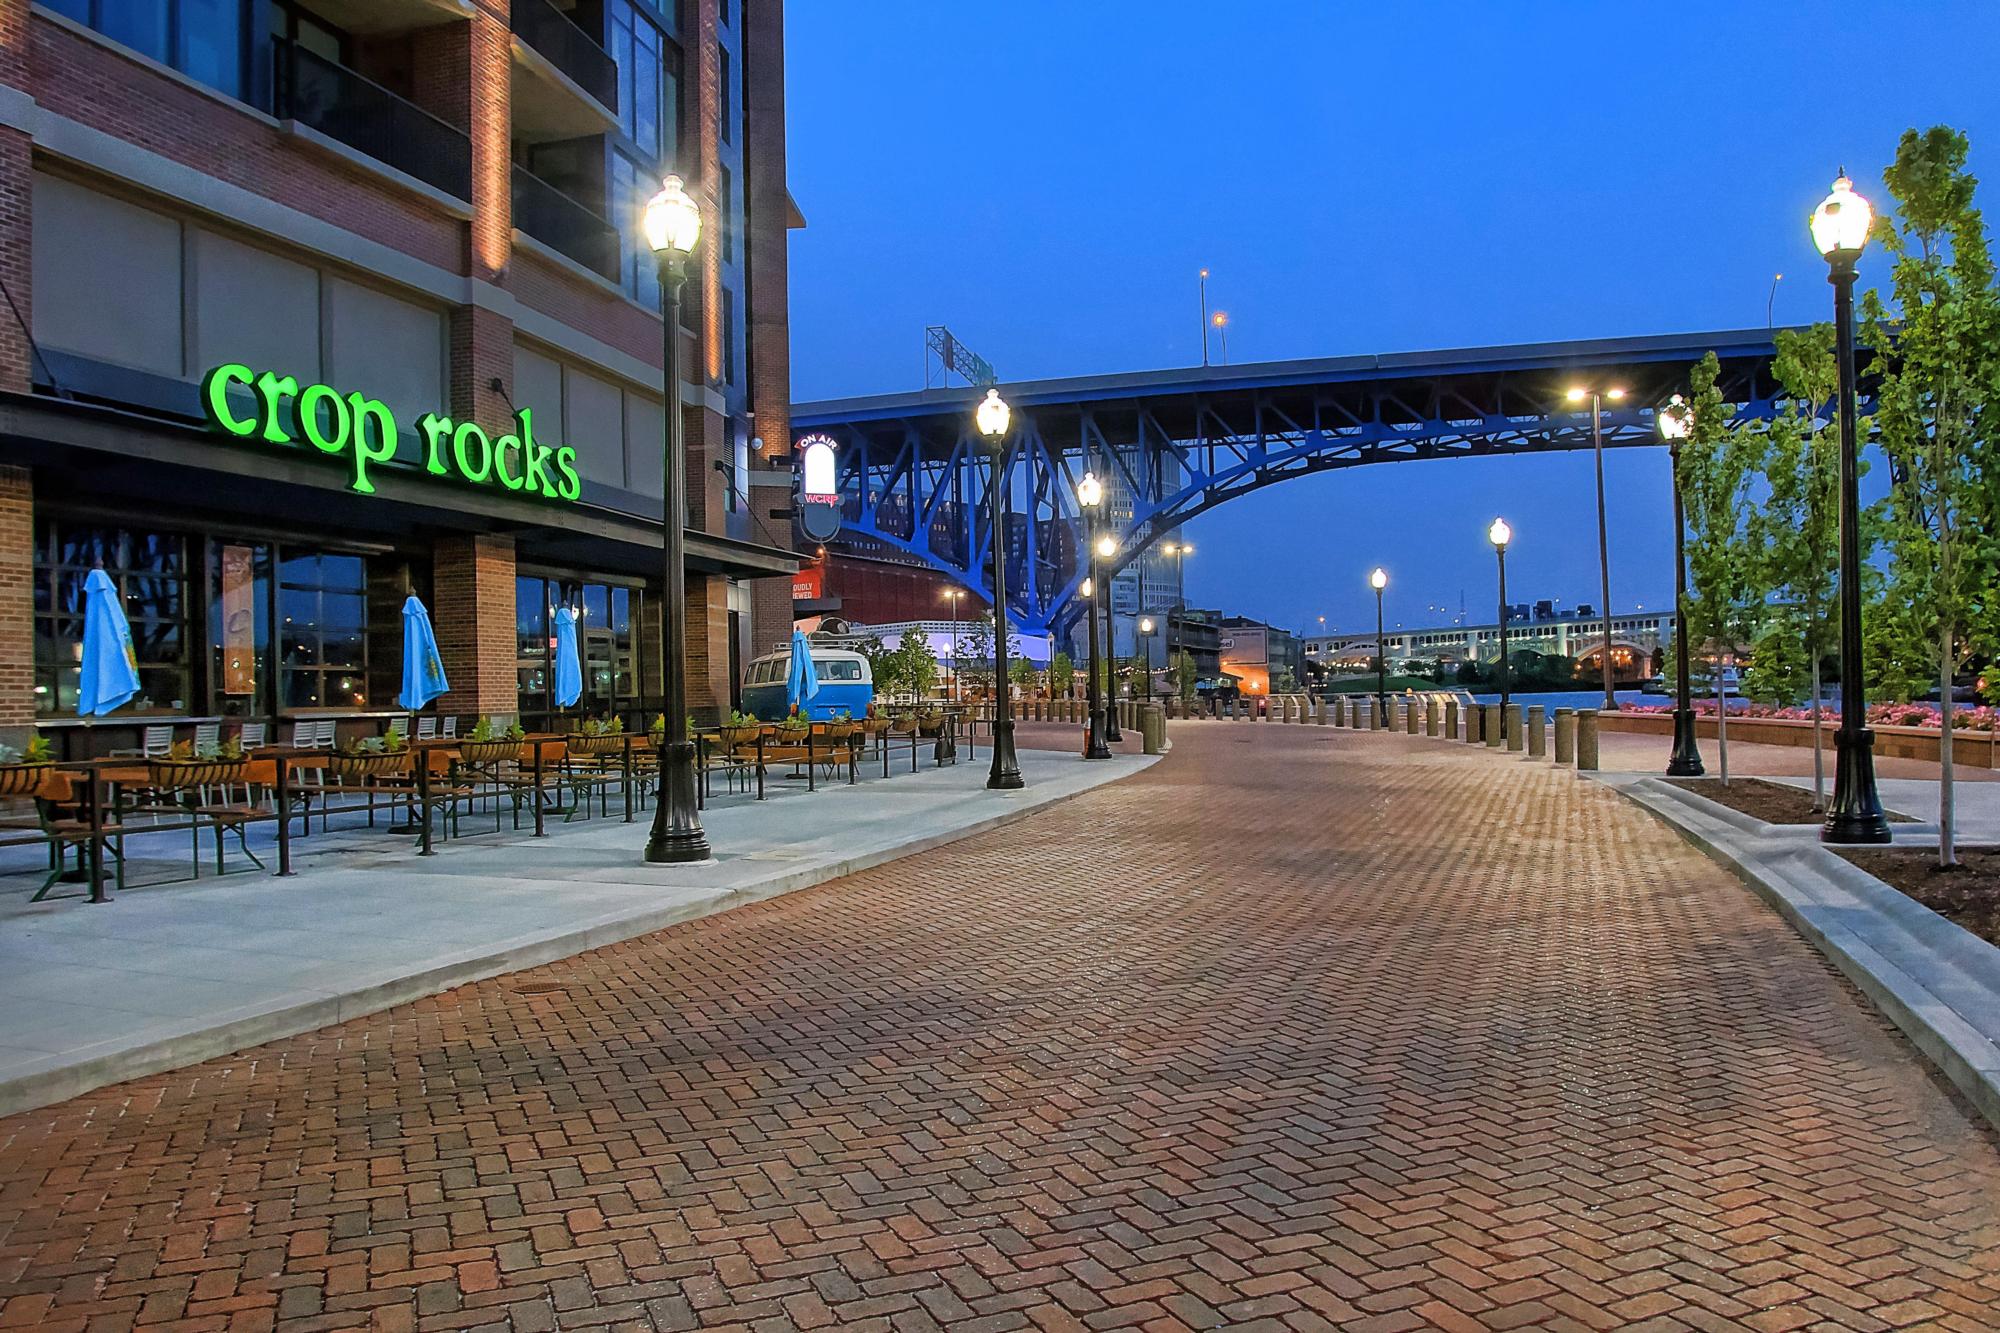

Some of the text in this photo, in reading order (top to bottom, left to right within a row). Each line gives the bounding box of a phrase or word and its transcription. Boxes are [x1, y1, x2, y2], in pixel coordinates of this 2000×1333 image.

[208, 363, 582, 501] crop rocks
[800, 434, 838, 450] ON AIR
